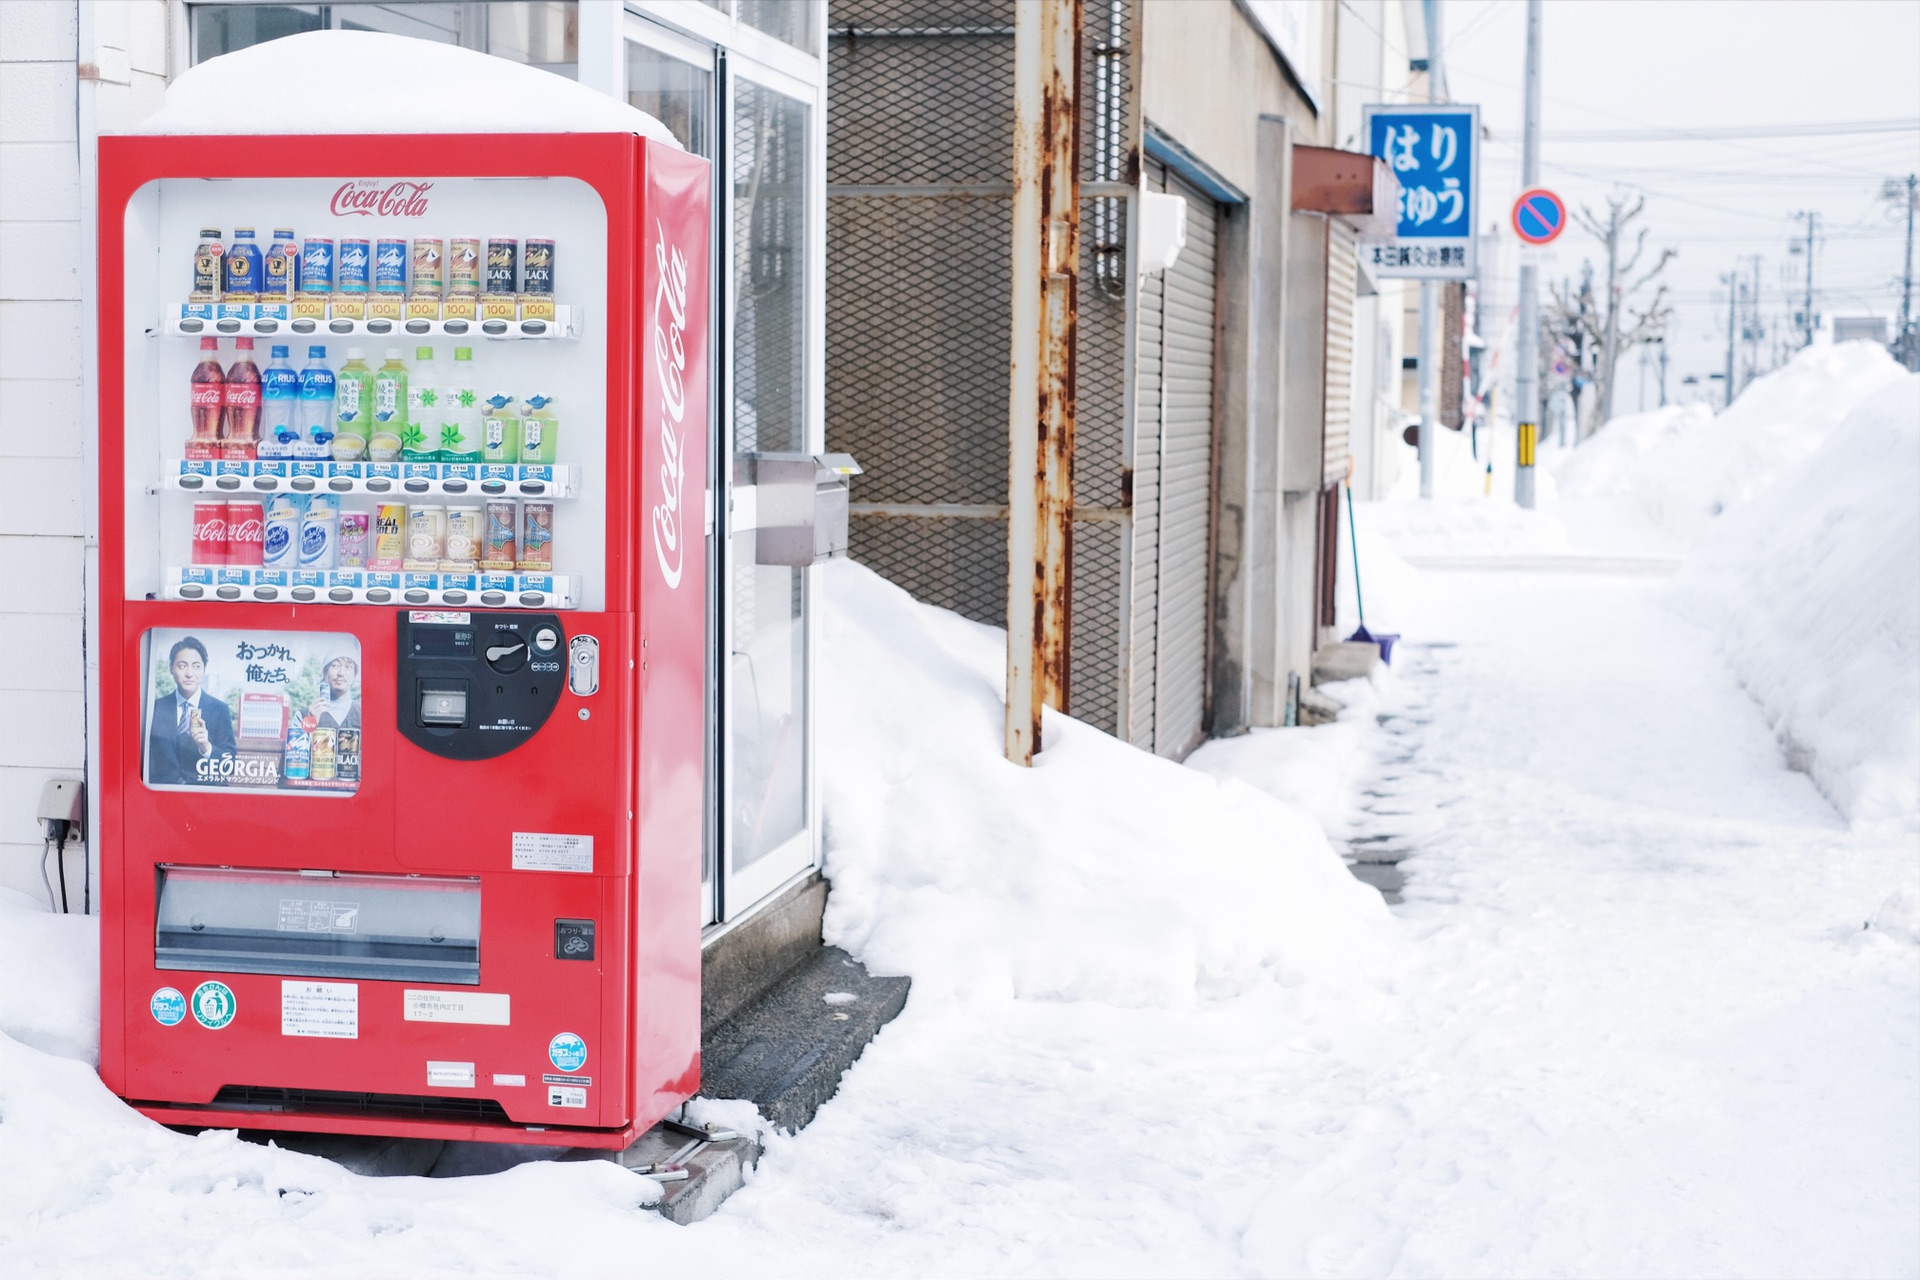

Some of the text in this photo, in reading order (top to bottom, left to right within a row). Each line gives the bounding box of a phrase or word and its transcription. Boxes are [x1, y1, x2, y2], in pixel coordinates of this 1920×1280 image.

[1383, 123, 1458, 172] はり
[358, 180, 379, 188] Enjoy!
[330, 182, 434, 216] Coca-Cola
[652, 216, 687, 589] Coca-Cola
[236, 641, 296, 662] おつかれ、
[246, 664, 290, 684] 俺たち。
[196, 752, 278, 778] GEORGIA
[198, 775, 279, 784] エメラルドマウンテンブレンド
